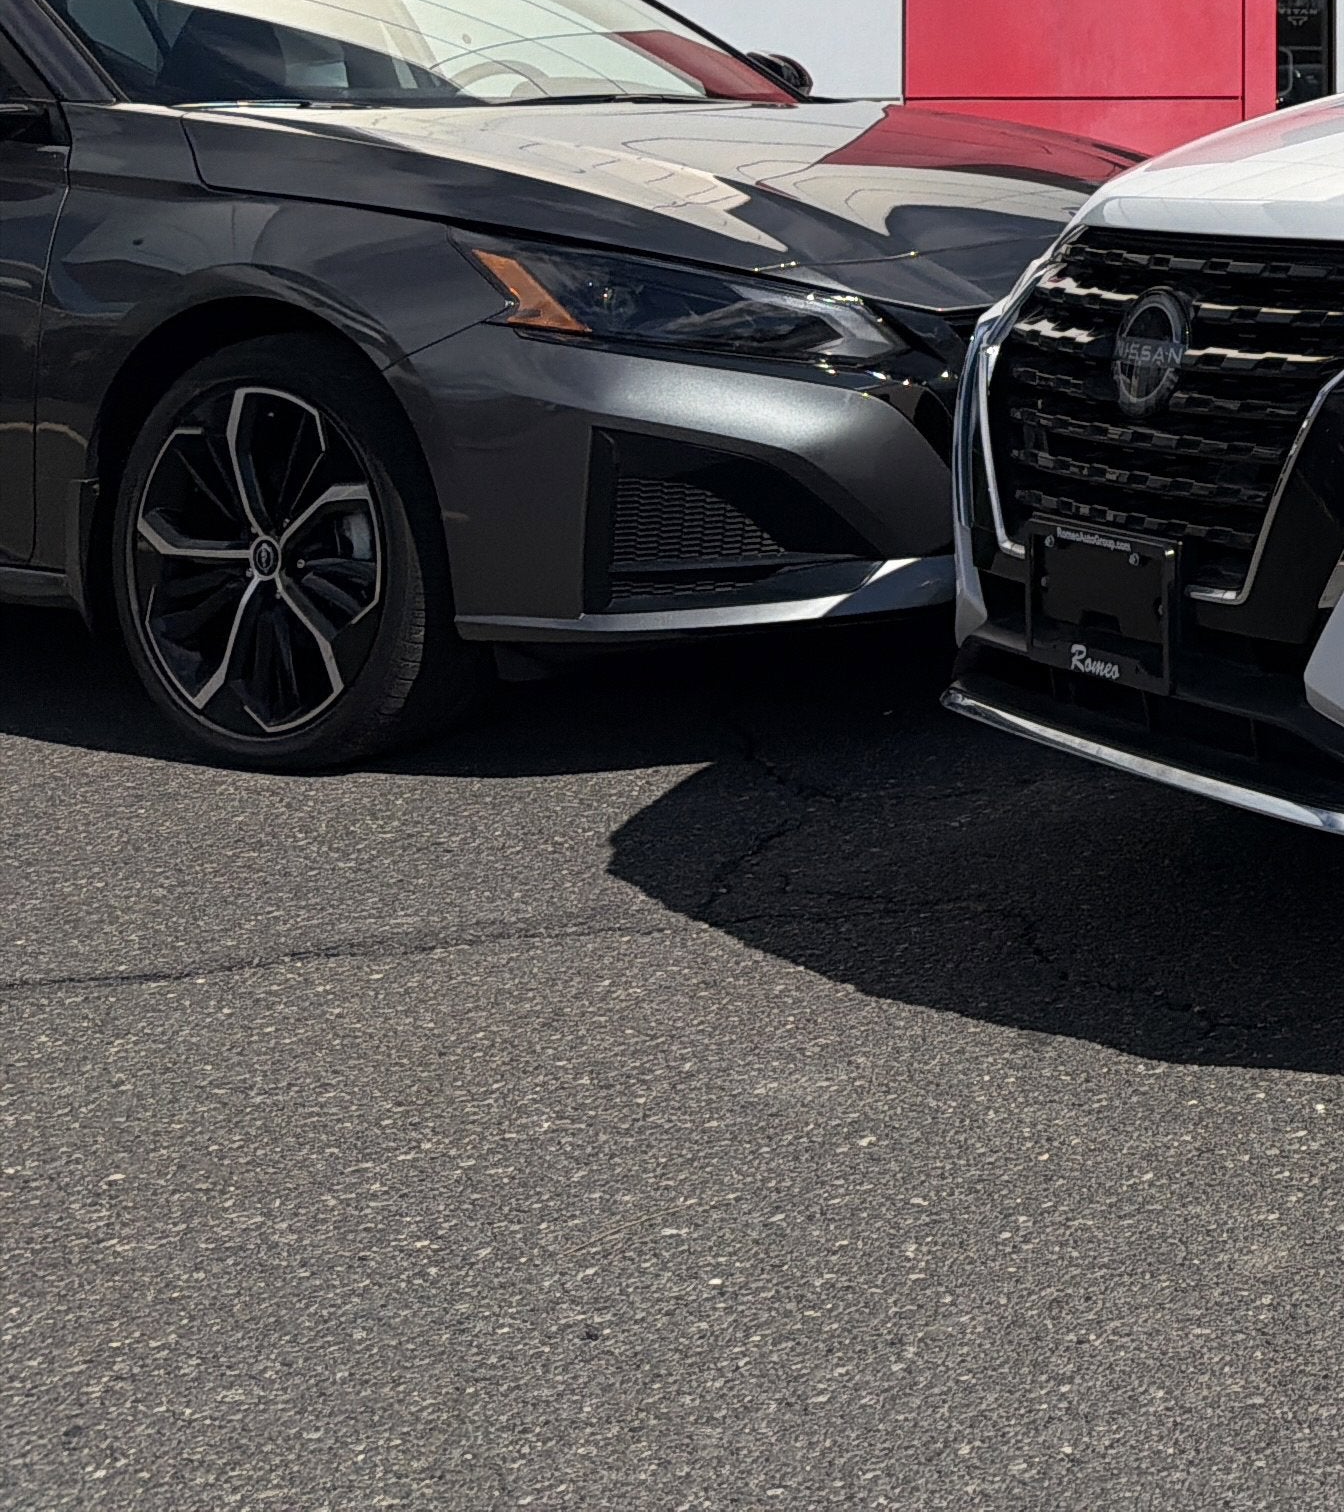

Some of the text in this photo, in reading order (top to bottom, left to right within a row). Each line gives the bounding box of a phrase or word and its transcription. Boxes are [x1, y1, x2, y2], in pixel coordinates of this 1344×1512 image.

[1115, 340, 1183, 364] NISSAN
[1056, 526, 1132, 553] RomeoAutoGroup.com
[1070, 643, 1121, 680] Romeo
